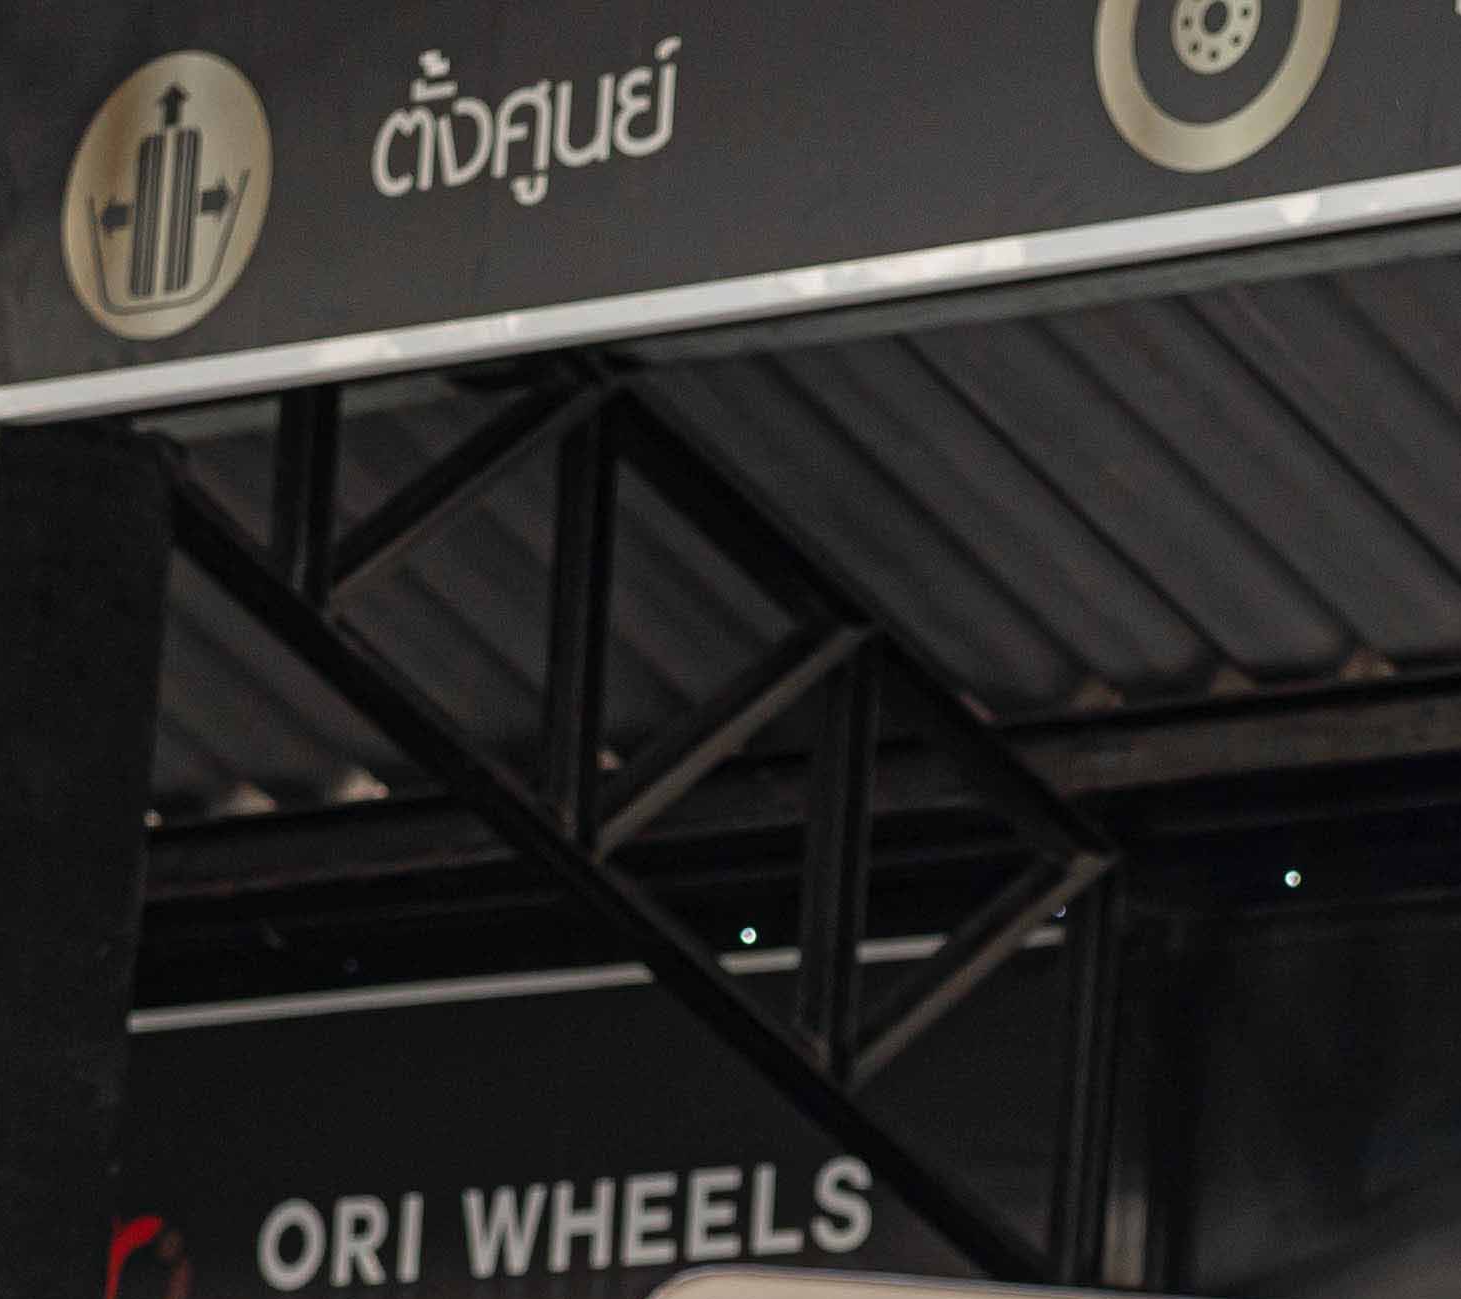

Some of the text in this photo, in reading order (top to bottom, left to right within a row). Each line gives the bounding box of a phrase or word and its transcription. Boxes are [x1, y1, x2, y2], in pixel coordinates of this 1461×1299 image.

[371, 35, 682, 206] ตั้งศูนย์
[255, 1155, 875, 1291] ORI WHEELS
